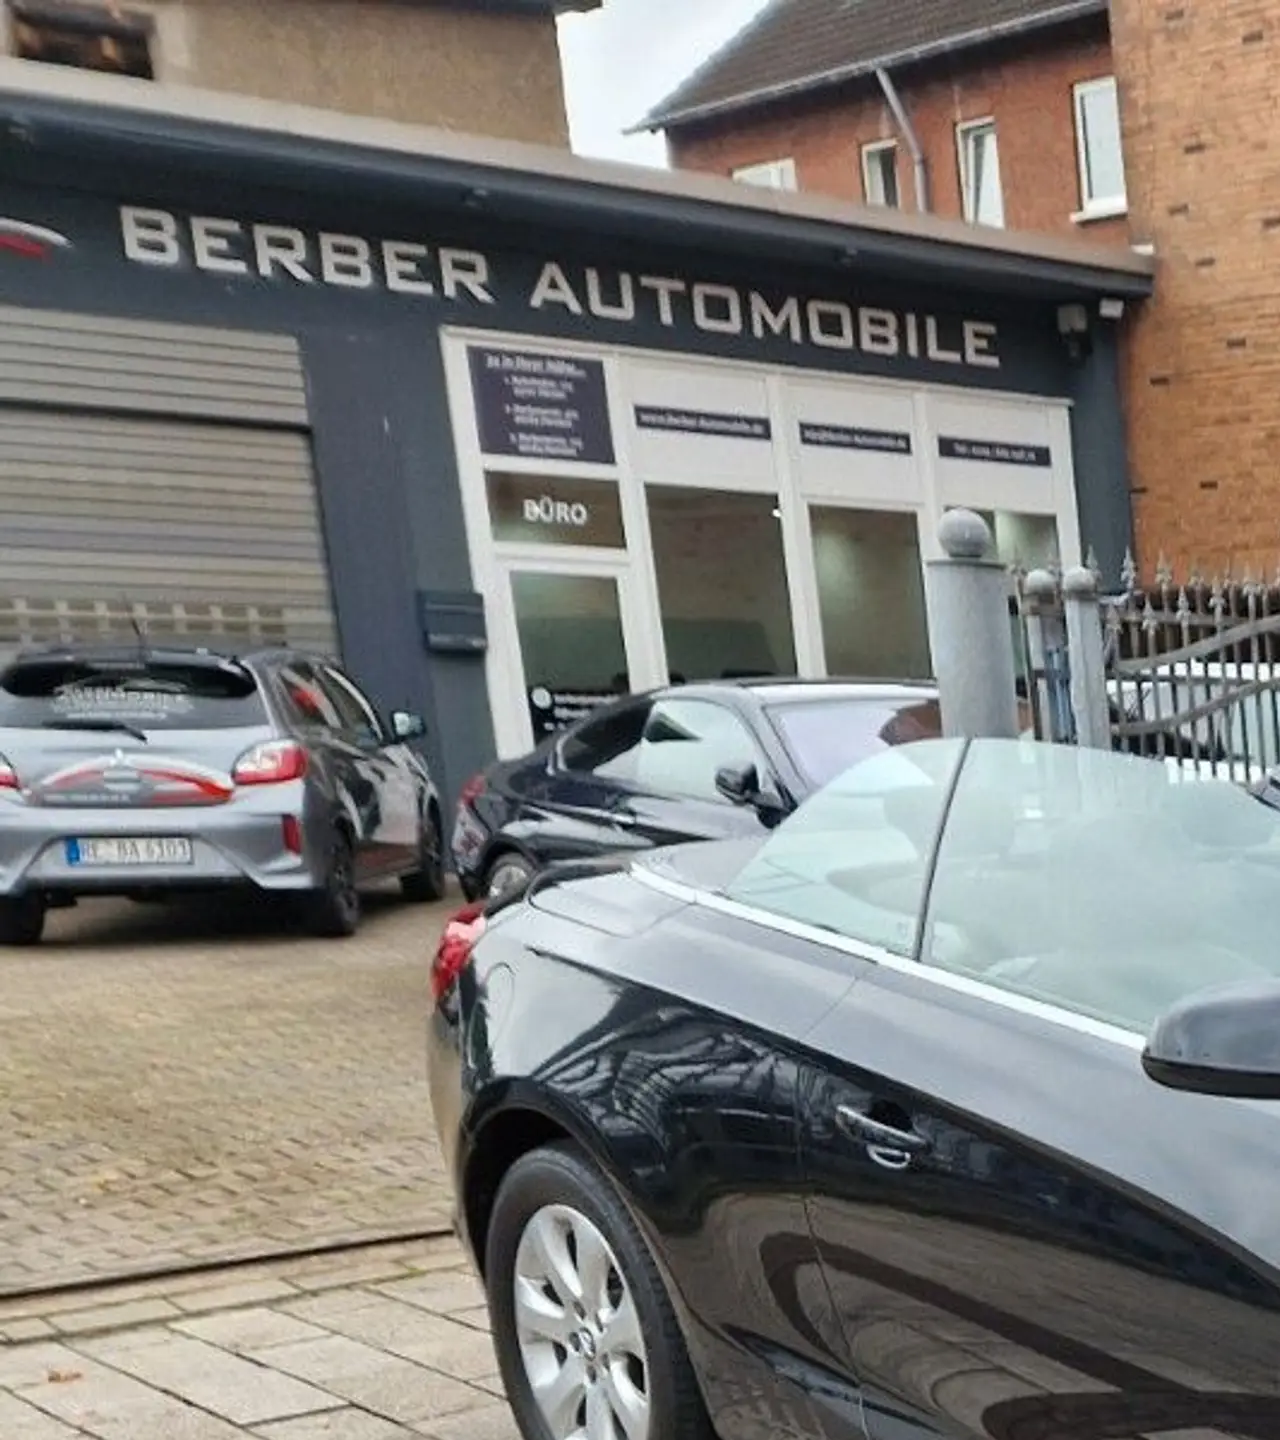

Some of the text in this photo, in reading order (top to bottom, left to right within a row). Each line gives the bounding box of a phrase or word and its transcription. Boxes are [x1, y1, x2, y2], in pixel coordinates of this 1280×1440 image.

[119, 205, 1000, 368] BERBER AUTOMOBILE
[523, 495, 588, 526] BÜRO
